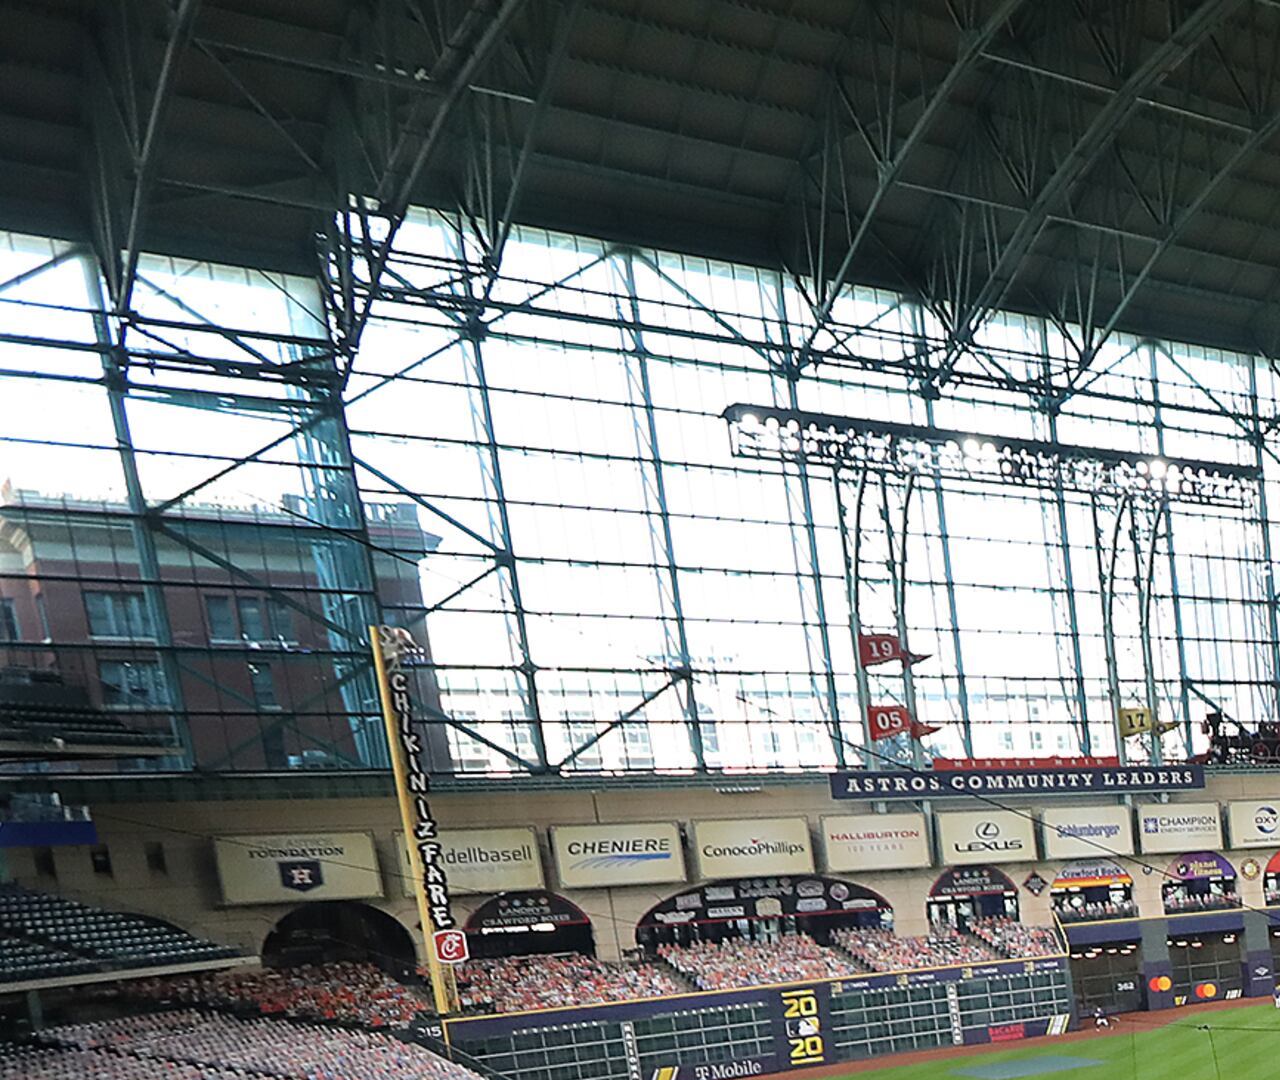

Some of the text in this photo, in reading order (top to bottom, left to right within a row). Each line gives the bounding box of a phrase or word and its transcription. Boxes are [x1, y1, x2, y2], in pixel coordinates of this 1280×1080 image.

[869, 640, 893, 658] 19
[876, 711, 903, 731] 05
[1125, 712, 1147, 729] 17
[847, 771, 1193, 793] ASTROS COMMUNITY LEADERS
[1159, 815, 1217, 827] CHAMPION
[1254, 815, 1280, 824] OXY
[830, 830, 919, 841] HALLIBURTON
[248, 846, 345, 859] FOUNDATION
[567, 838, 671, 856] CHENIERE
[702, 838, 806, 858] ConocoPhillips
[954, 839, 1023, 853] LEXUS
[1117, 981, 1135, 991] 362
[783, 996, 818, 1018] 20
[789, 1036, 824, 1058] 20
